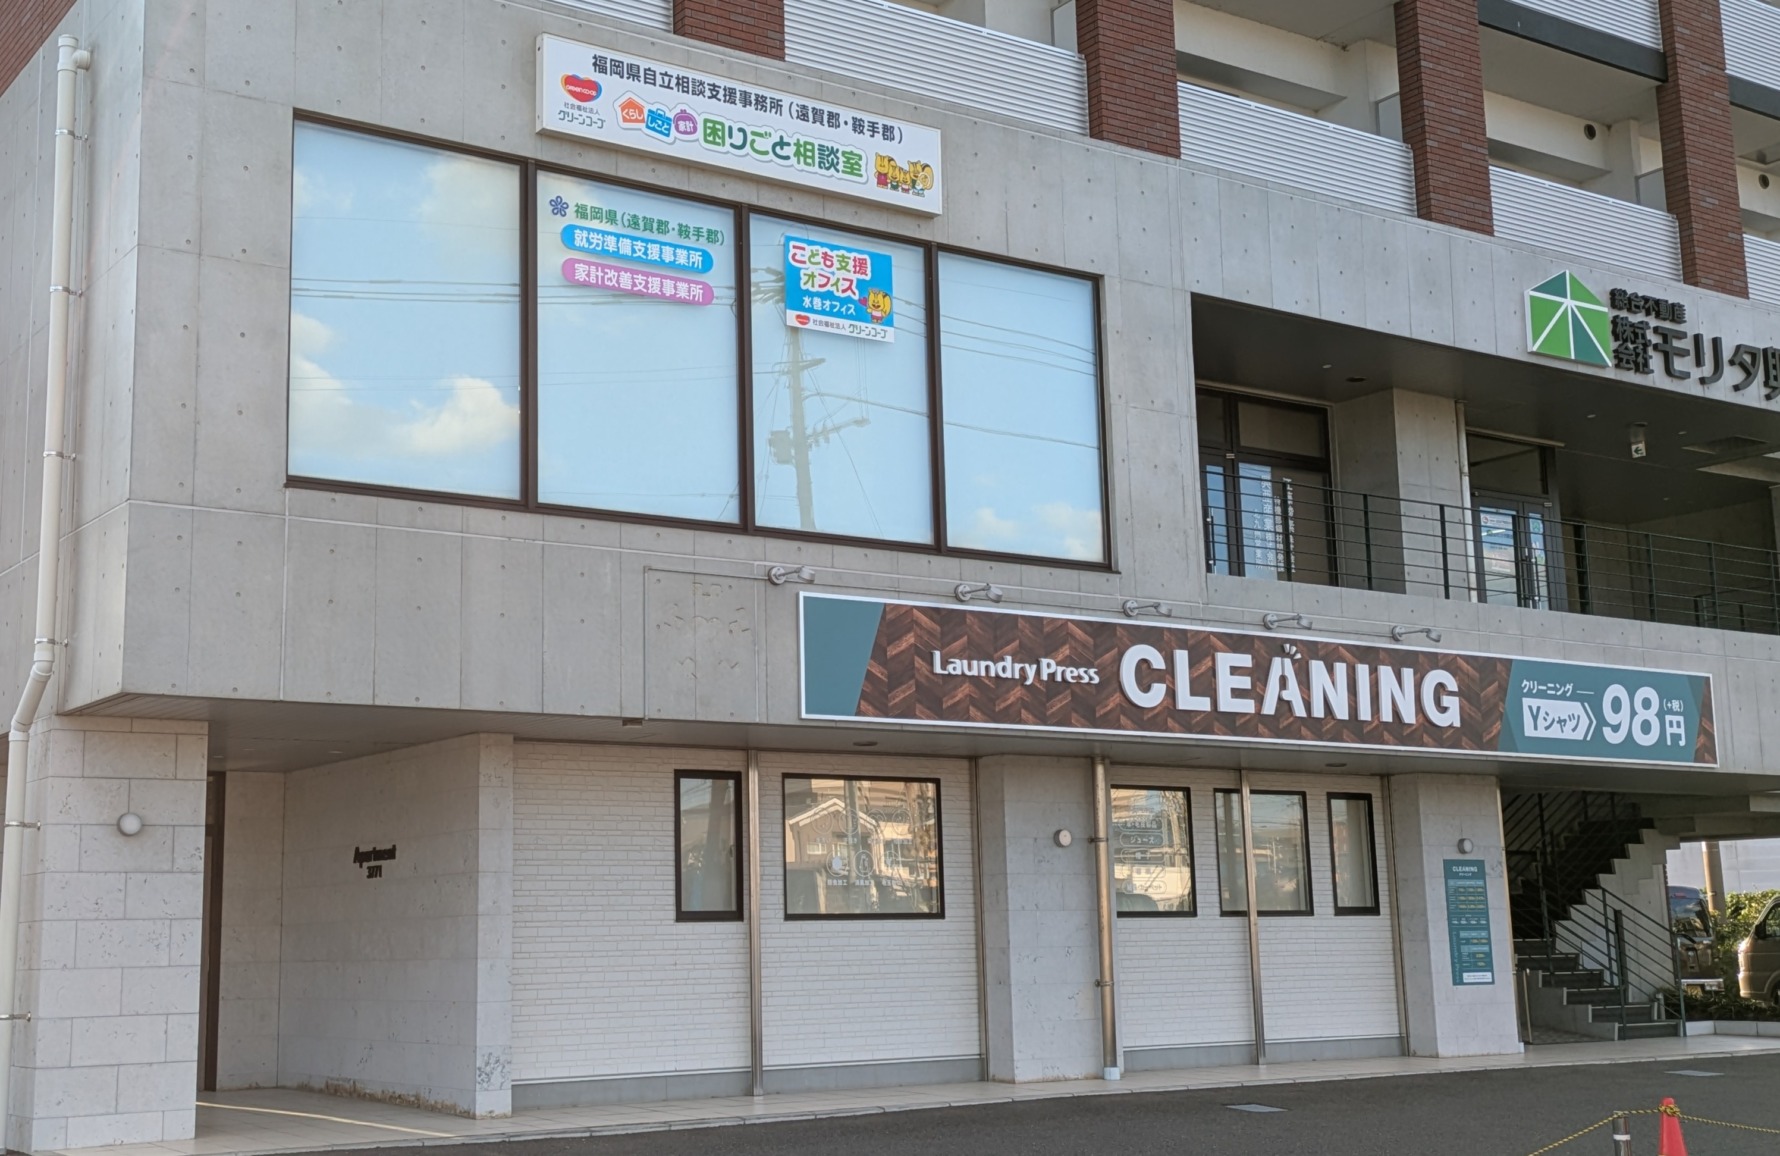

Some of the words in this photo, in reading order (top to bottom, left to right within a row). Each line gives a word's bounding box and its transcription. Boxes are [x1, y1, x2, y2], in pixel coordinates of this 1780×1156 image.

[563, 101, 600, 116] 社会福祉法人
[621, 108, 644, 121] くらし
[647, 115, 670, 134] しごと
[677, 119, 695, 132] 家計
[702, 117, 865, 179] 困りごと相談室
[573, 229, 703, 269] 就労準備支援事業所
[791, 244, 868, 277] こども支援
[574, 263, 704, 302] 家計改善支援事業所
[803, 271, 857, 296] オフィス
[802, 295, 856, 316] 水巻オフィス
[1119, 643, 1462, 728] CLEANING
[1521, 679, 1574, 697] クリーニング
[1527, 704, 1581, 734] Yシャツ
[1452, 865, 1478, 873] CLEANING
